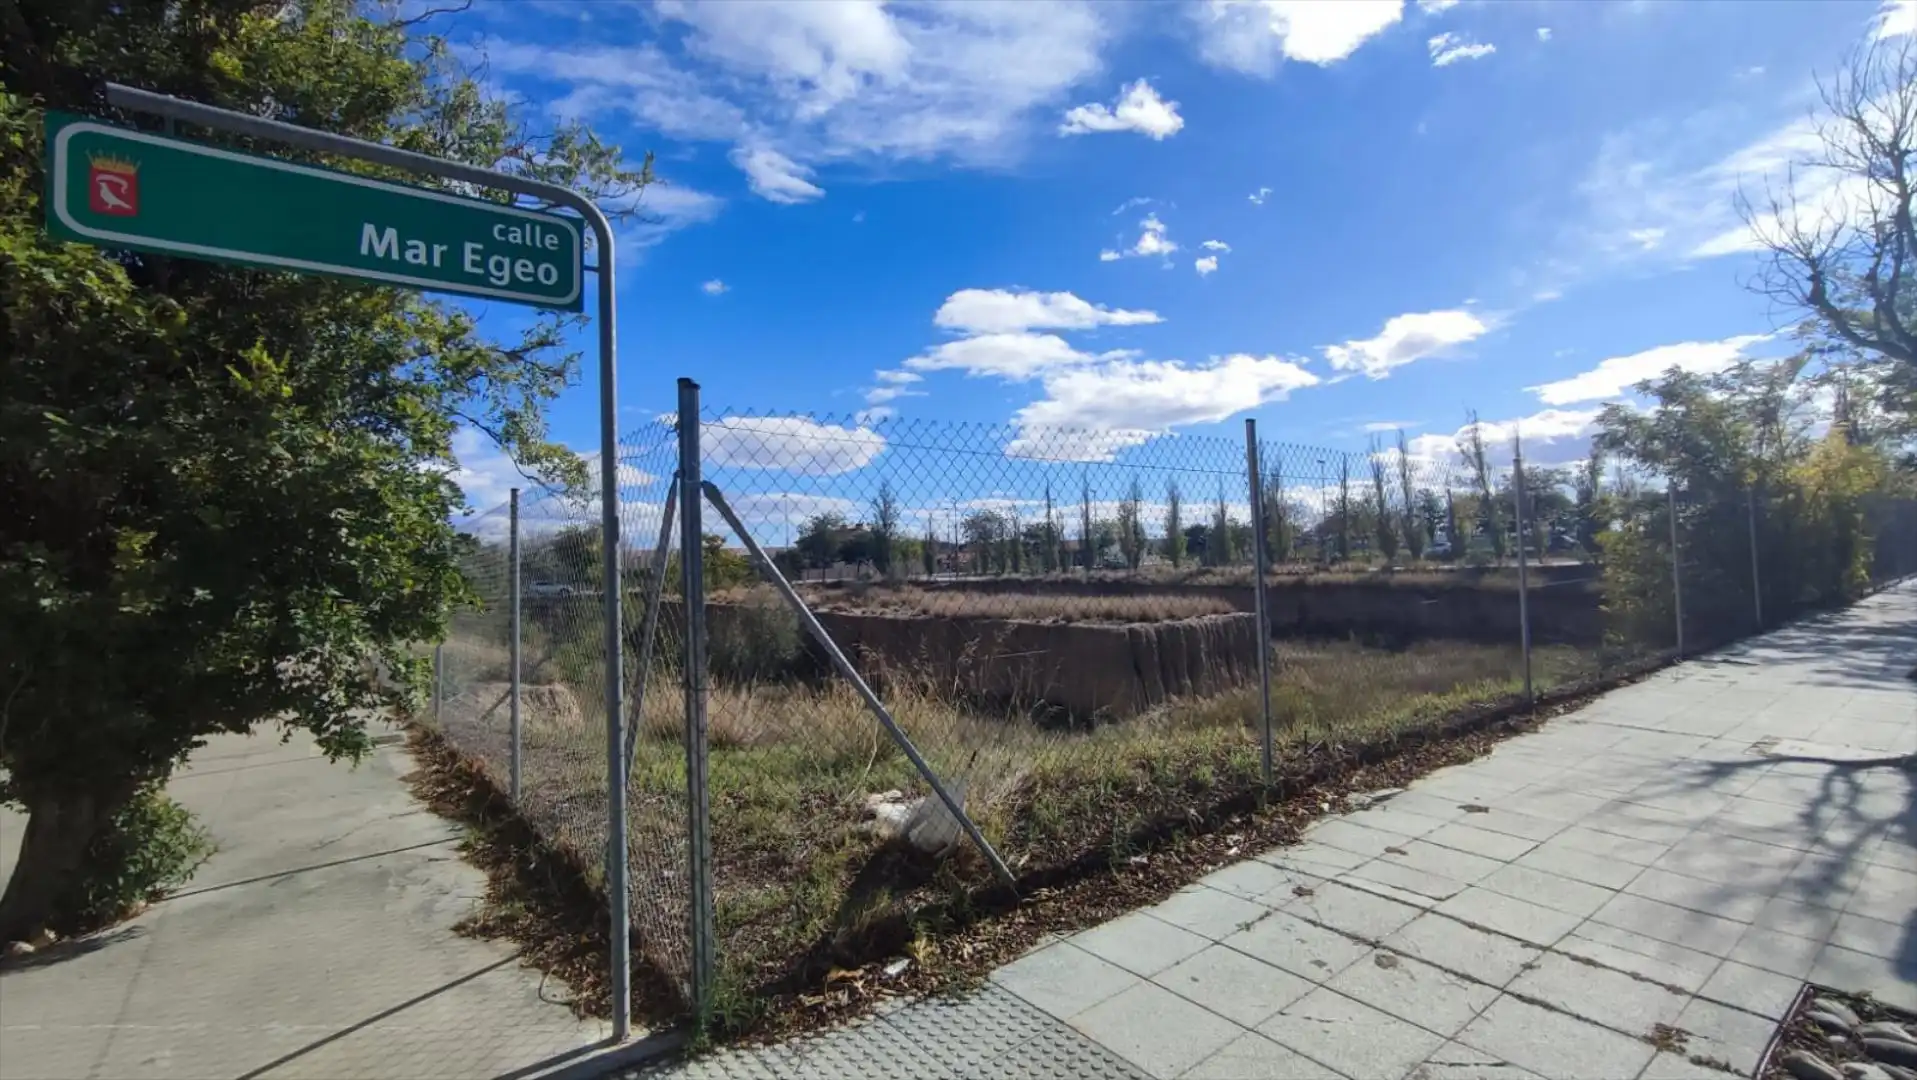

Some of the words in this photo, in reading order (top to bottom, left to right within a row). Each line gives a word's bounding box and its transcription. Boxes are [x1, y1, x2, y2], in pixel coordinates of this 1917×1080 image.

[359, 222, 448, 268] Mar
[463, 242, 559, 287] Egeo
[492, 223, 560, 251] calle
